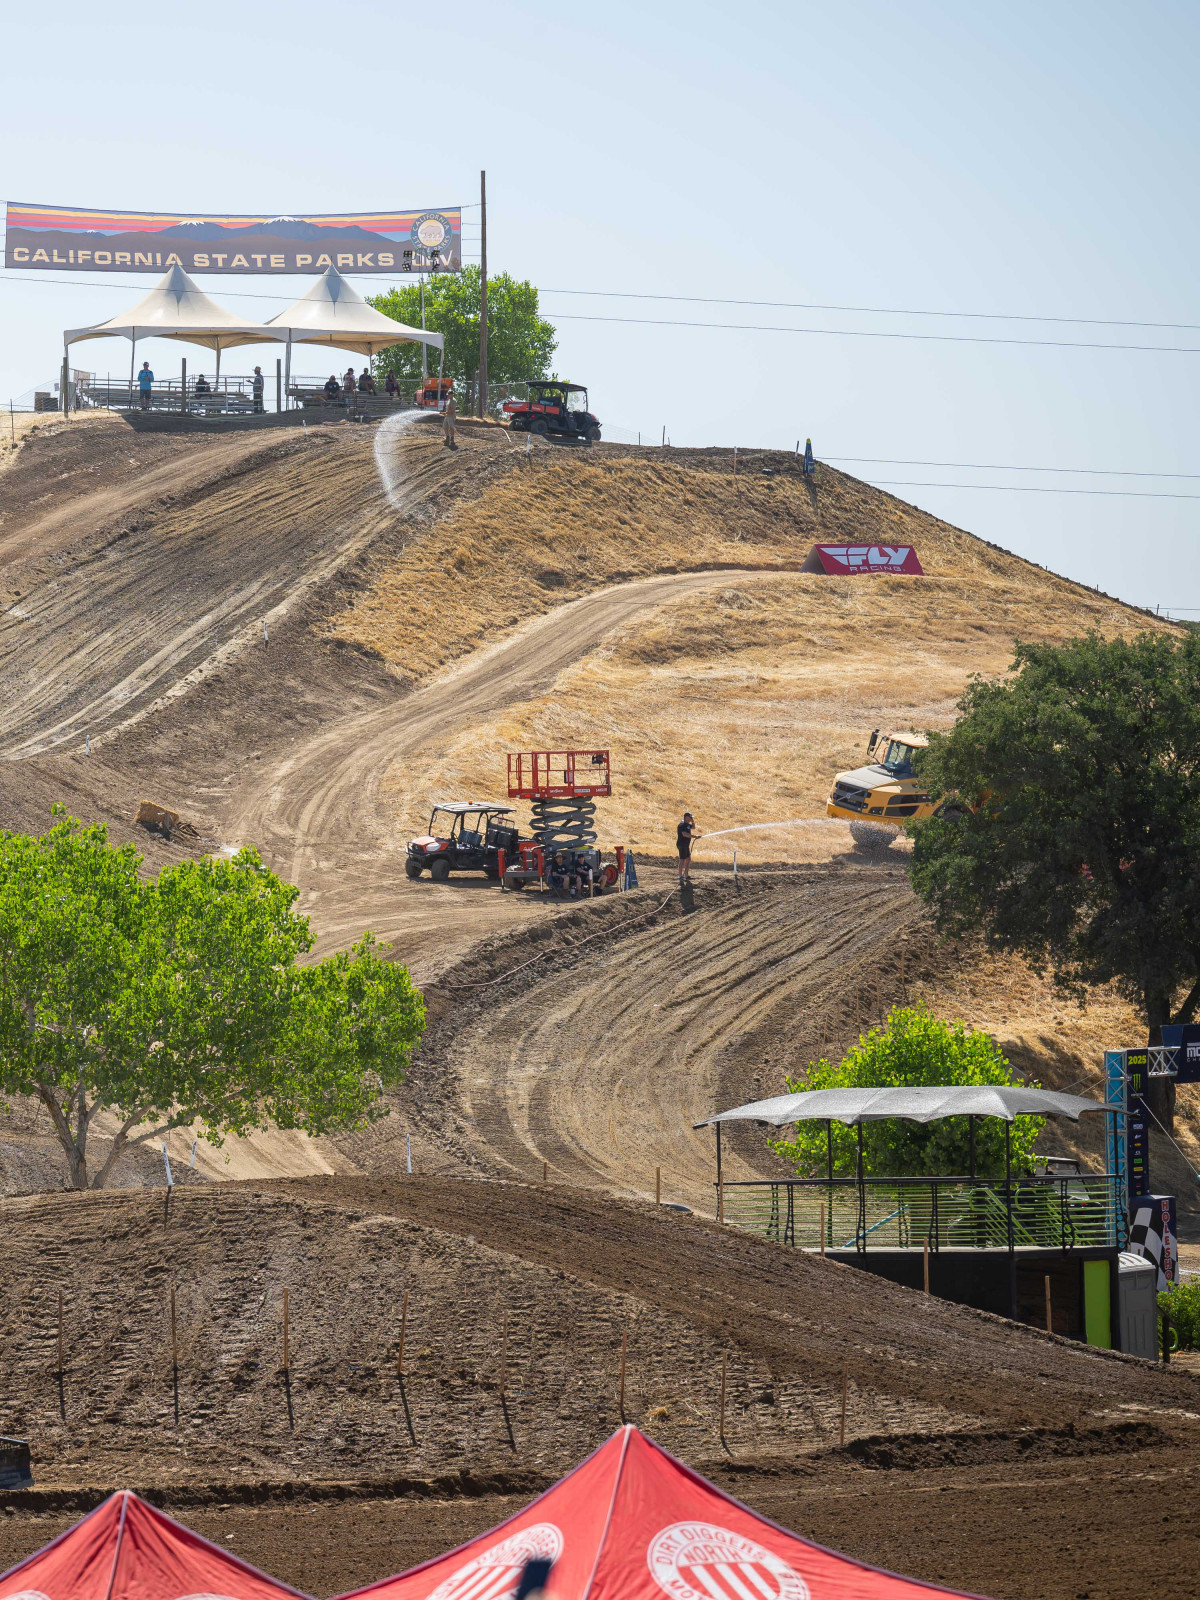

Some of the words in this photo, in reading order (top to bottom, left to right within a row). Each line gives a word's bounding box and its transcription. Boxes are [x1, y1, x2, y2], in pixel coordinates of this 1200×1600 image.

[412, 213, 450, 231] CALIFORNIA
[13, 247, 184, 266] CALIFORNIA
[193, 253, 285, 268] STATE
[296, 252, 395, 267] PARKS
[824, 546, 911, 566] FLY
[1128, 1055, 1147, 1065] 2025
[655, 1535, 681, 1566] DIRT
[679, 1526, 768, 1561] DIGGERS
[683, 1543, 743, 1563] NORTH
